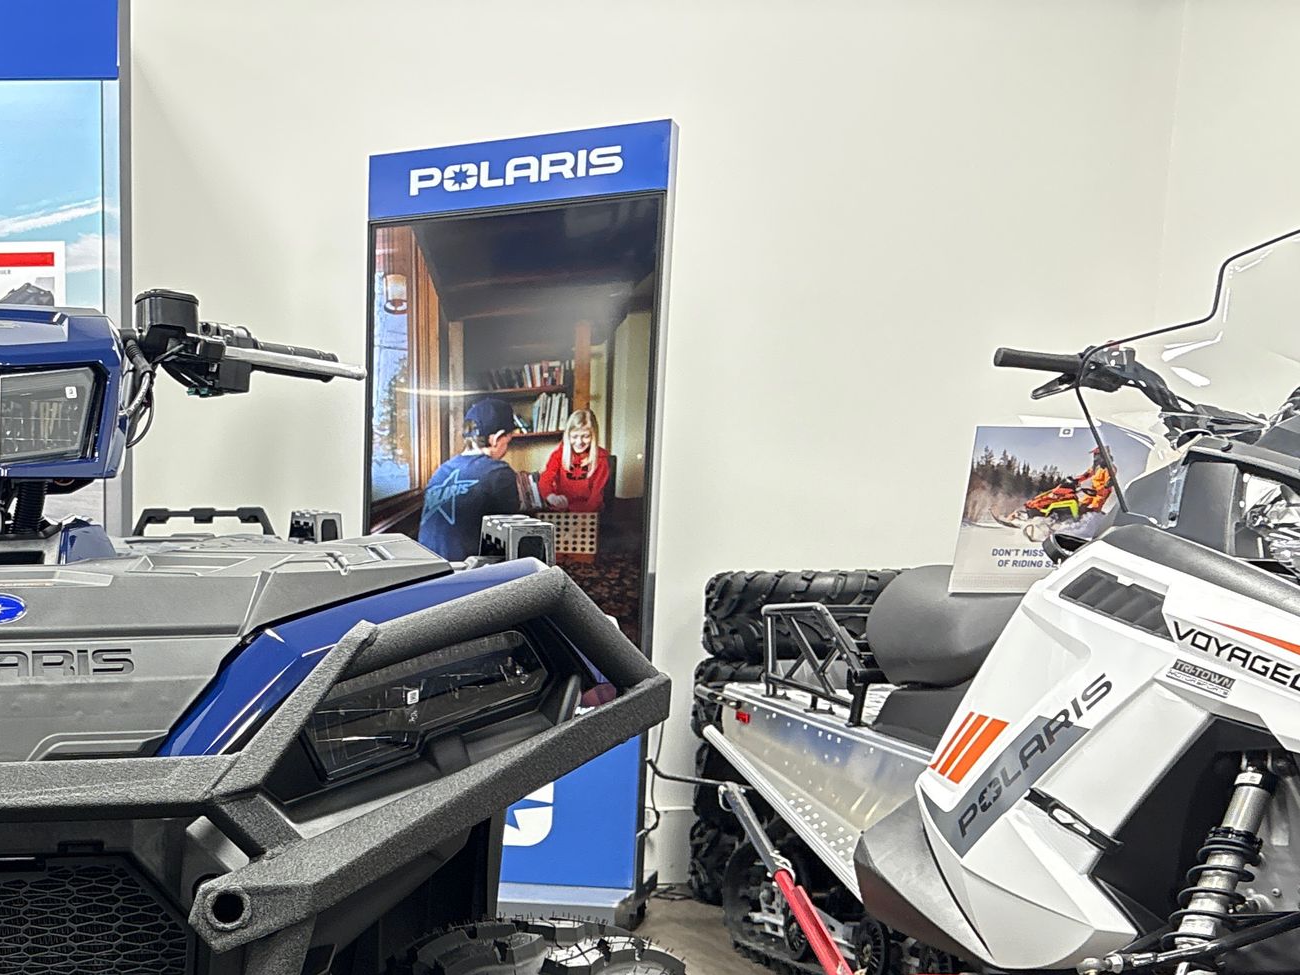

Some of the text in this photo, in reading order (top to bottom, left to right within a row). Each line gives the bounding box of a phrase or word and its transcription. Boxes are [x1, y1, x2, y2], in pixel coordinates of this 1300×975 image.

[409, 145, 624, 197] POLARIS
[991, 548, 1045, 557] DON'T MISS
[1011, 560, 1044, 568] RIDING
[1174, 660, 1235, 690] TRI-TOWN
[957, 673, 1113, 838] POLARIS
